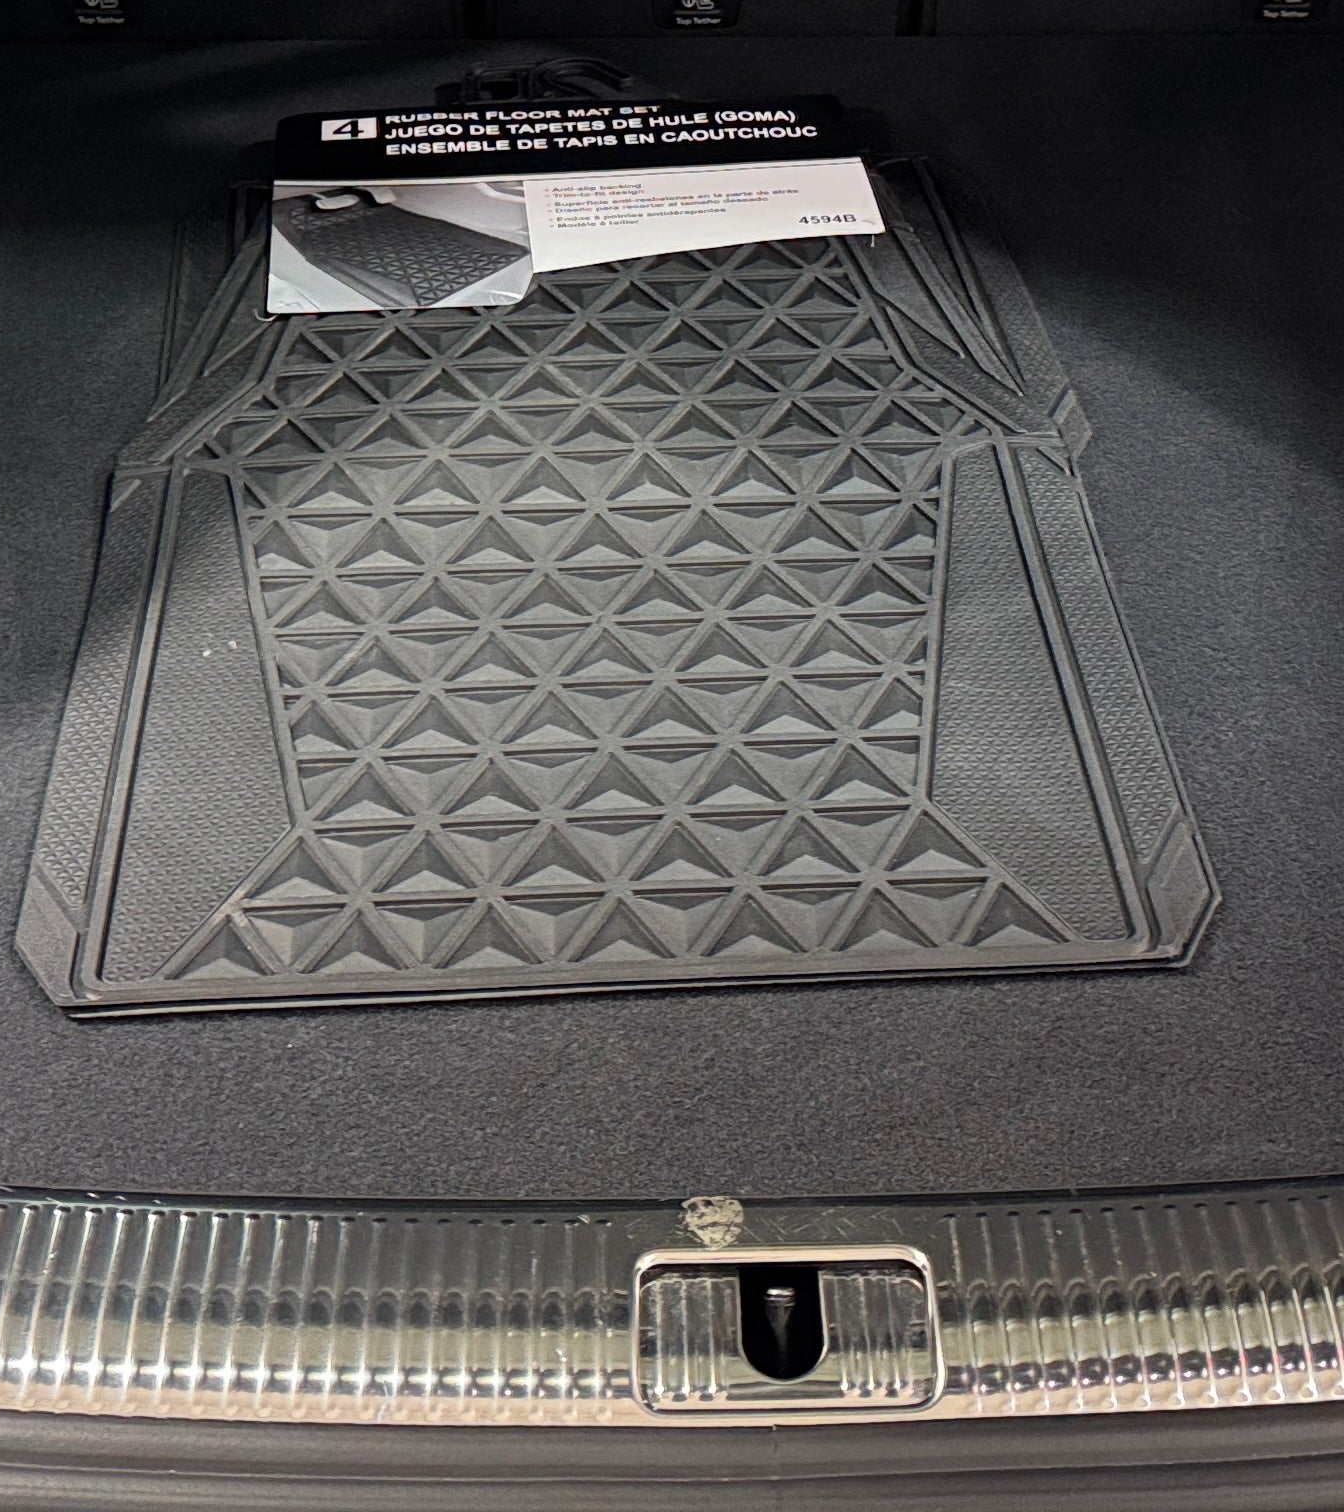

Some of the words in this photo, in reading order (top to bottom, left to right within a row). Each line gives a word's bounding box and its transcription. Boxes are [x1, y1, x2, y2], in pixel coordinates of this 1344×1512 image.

[384, 124, 463, 139] JUEGO
[470, 125, 500, 136] DE
[506, 120, 606, 135] TAPETES
[612, 118, 643, 130] DE
[649, 113, 708, 127] HULE
[714, 110, 796, 125] (GOMA)
[386, 111, 479, 124] RUBBER
[486, 110, 562, 120] FLOOR
[567, 107, 613, 118] MAT
[619, 105, 661, 115] SET
[333, 118, 365, 138] 4
[386, 139, 511, 155] ENSEMBLE
[517, 138, 548, 150] DE
[554, 135, 618, 149] TAPIS
[624, 133, 655, 145] EN
[661, 126, 818, 143] CAOUTCHOUC
[798, 214, 857, 224] 4594B
